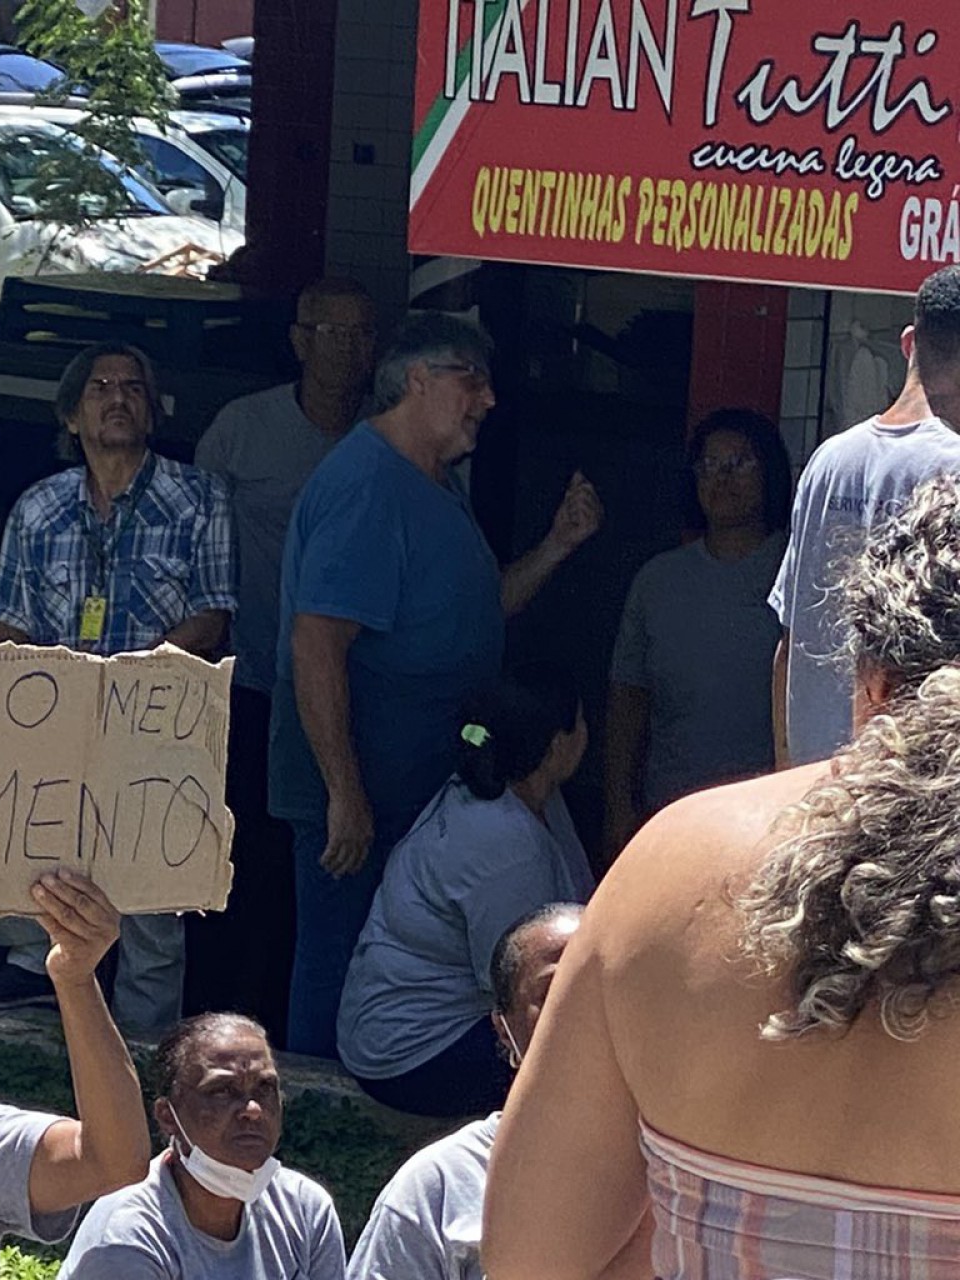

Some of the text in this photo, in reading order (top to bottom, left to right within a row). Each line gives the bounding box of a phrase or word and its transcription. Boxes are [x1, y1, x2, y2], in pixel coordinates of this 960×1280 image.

[689, 0, 951, 132] Tutti
[692, 136, 942, 199] cucina legera
[471, 166, 860, 260] QUENTINHAS PERSONALIZADAS
[5, 670, 60, 729] O
[102, 679, 208, 741] MEU
